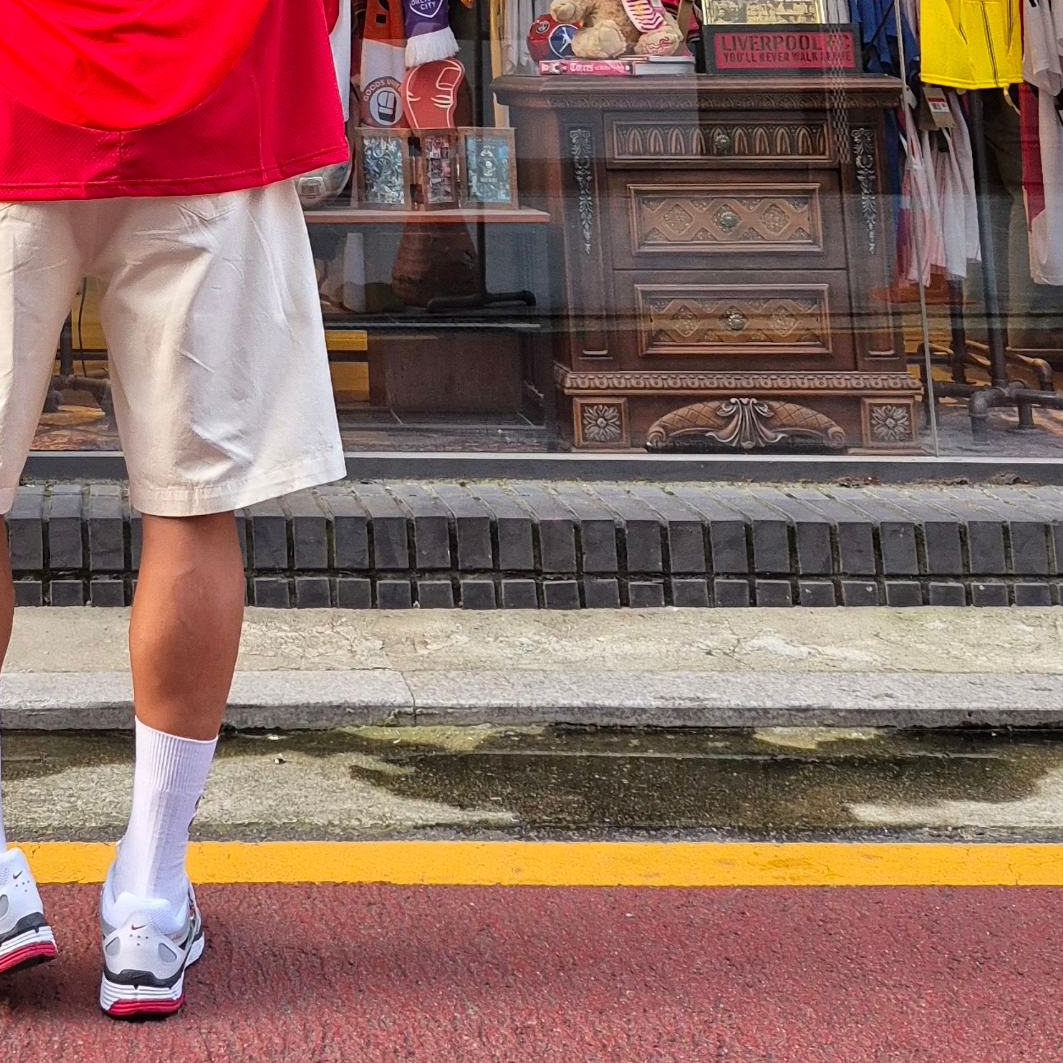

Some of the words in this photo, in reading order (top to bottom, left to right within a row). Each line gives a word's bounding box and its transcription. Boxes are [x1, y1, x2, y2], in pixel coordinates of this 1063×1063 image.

[420, 1, 436, 10] CITY
[721, 35, 822, 52] LIVERPOOL
[723, 52, 757, 63] YOU'LL
[759, 52, 790, 62] NEVER
[791, 51, 818, 62] WALK
[363, 80, 385, 102] GOODS
